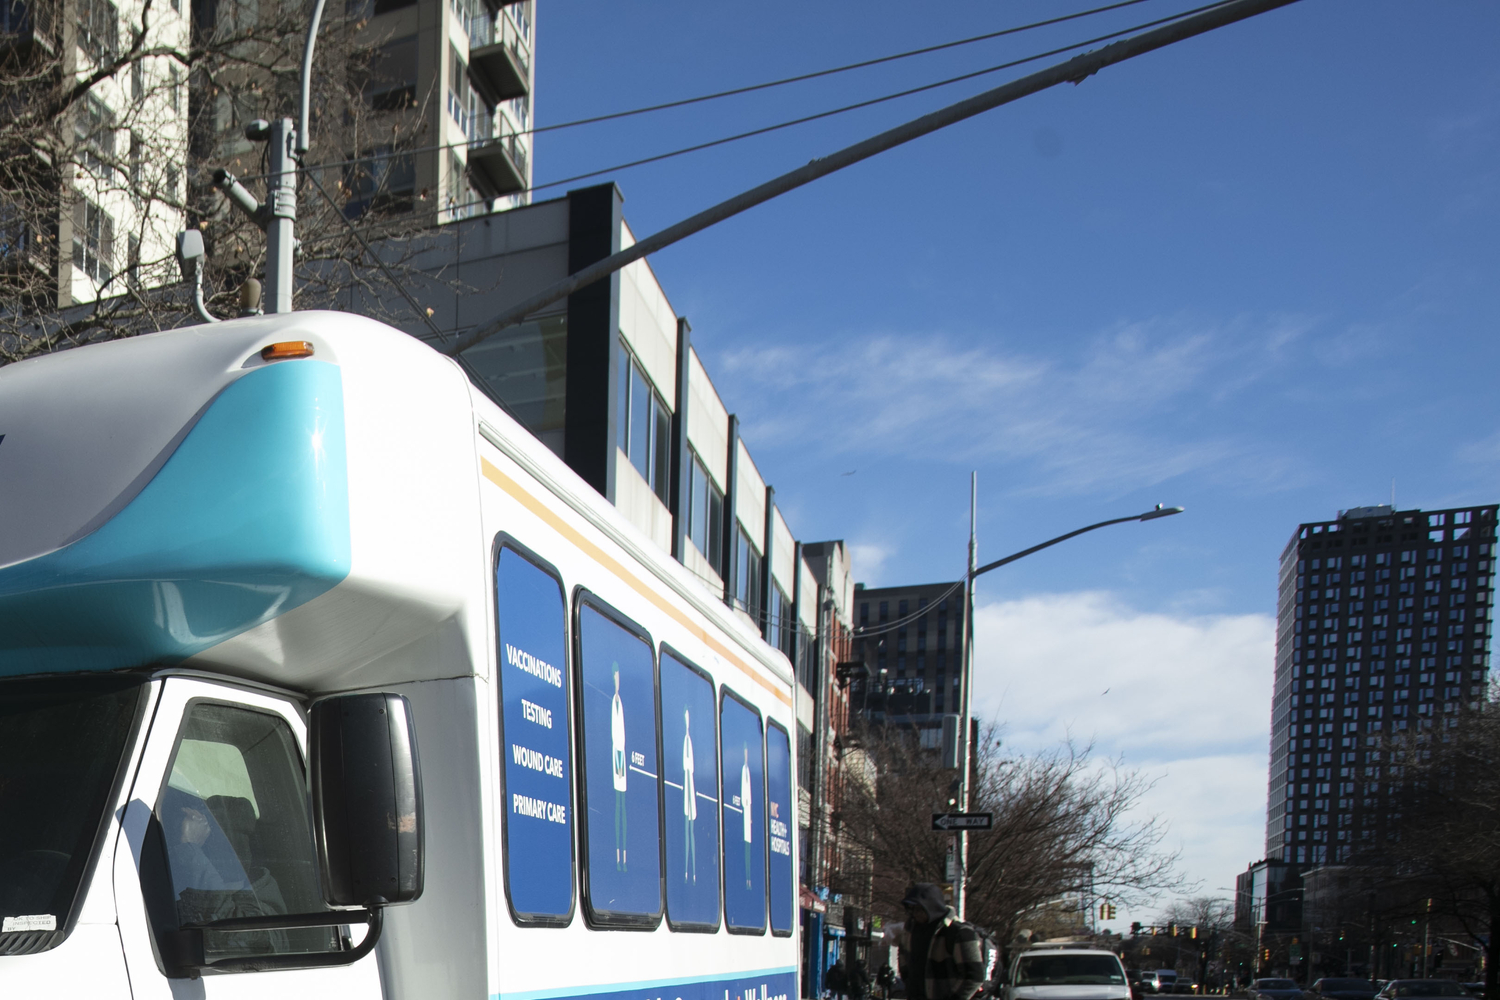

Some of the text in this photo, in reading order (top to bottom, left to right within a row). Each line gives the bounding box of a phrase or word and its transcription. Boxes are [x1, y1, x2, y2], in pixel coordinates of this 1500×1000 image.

[506, 643, 562, 688] VACCINATIONS
[521, 699, 552, 729] TESTING
[512, 744, 563, 778] WOUND CARE
[635, 752, 645, 767] FEET
[513, 794, 566, 825] PRIMARY CARE
[966, 818, 984, 826] WAY
[771, 835, 789, 856] HOSPITALS
